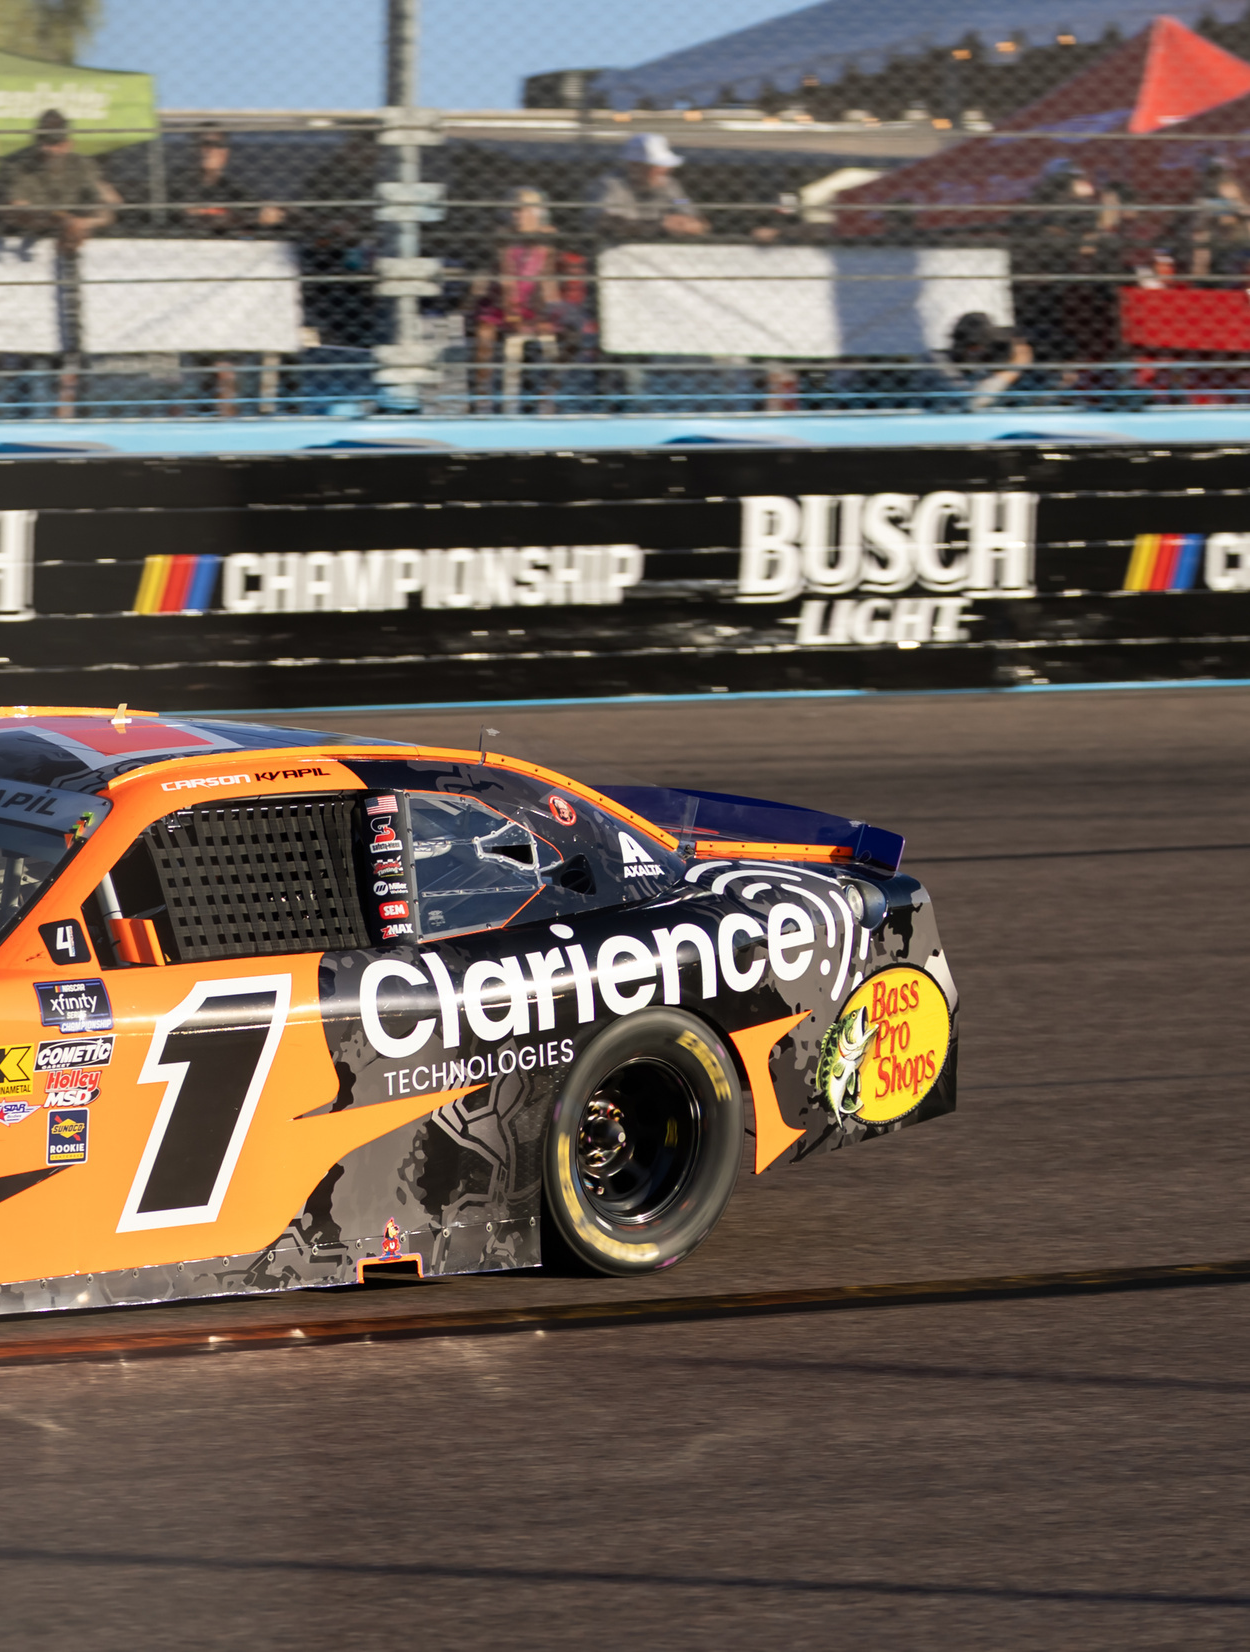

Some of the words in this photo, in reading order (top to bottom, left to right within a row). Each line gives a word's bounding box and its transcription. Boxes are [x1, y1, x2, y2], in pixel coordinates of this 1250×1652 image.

[736, 491, 1039, 602] BUSCH
[222, 544, 644, 614] CHAMPIONSHIP
[795, 597, 974, 645] LIGHT
[161, 774, 251, 792] CARSON
[254, 767, 331, 783] KVAPIL
[623, 864, 665, 879] AXALTA
[383, 904, 406, 917] SEM
[56, 925, 76, 957] 4
[62, 983, 86, 993] NASCAR
[359, 902, 815, 1059] Clarience
[50, 992, 98, 1016] xfinity
[870, 979, 920, 1023] Bass
[61, 1019, 112, 1032] CHAMPIONSHIP
[873, 1019, 911, 1059] Pro
[37, 1039, 112, 1066] COMETIC
[384, 1038, 575, 1096] TECHNOLOGIES
[875, 1049, 936, 1099] Shops
[46, 1069, 101, 1092] Holley
[4, 1103, 26, 1113] STAR
[43, 1090, 91, 1108] MSD
[116, 973, 292, 1234] 1
[53, 1123, 83, 1133] SUNOCO
[50, 1143, 85, 1154] ROOKIE
